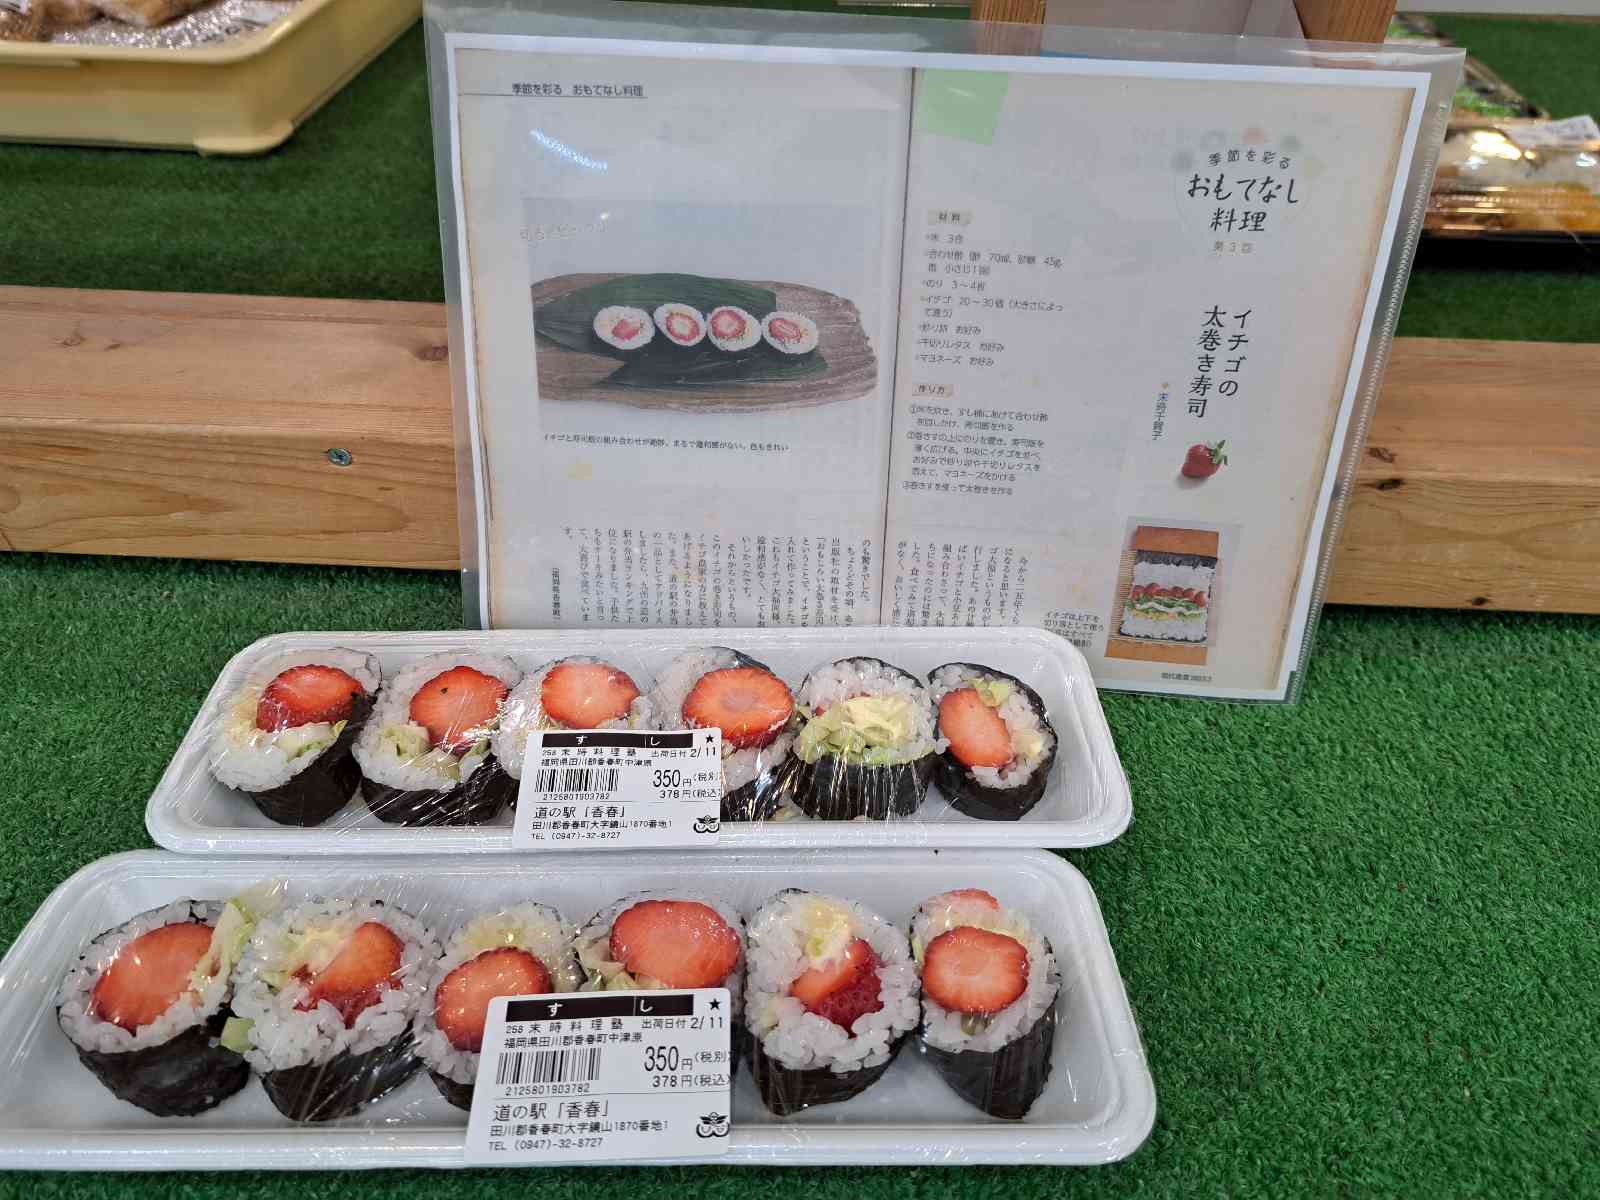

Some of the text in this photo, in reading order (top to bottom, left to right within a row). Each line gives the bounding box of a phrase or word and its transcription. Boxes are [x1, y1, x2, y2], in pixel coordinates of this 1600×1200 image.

[512, 83, 644, 97] 季節を彩る おもてなし料理
[1208, 150, 1291, 169] 季節を彩る
[1187, 173, 1298, 203] おもてなし
[1210, 208, 1267, 232] 料理
[1187, 305, 1227, 418] 太巻き寿司
[1219, 309, 1252, 396] イチゴの
[917, 384, 945, 395] 作り方
[533, 806, 625, 819] 道の駅「香春」
[506, 1083, 590, 1096] 2125801903782
[493, 1100, 609, 1122] 道の駅「香春」
[488, 1141, 506, 1151] TEL
